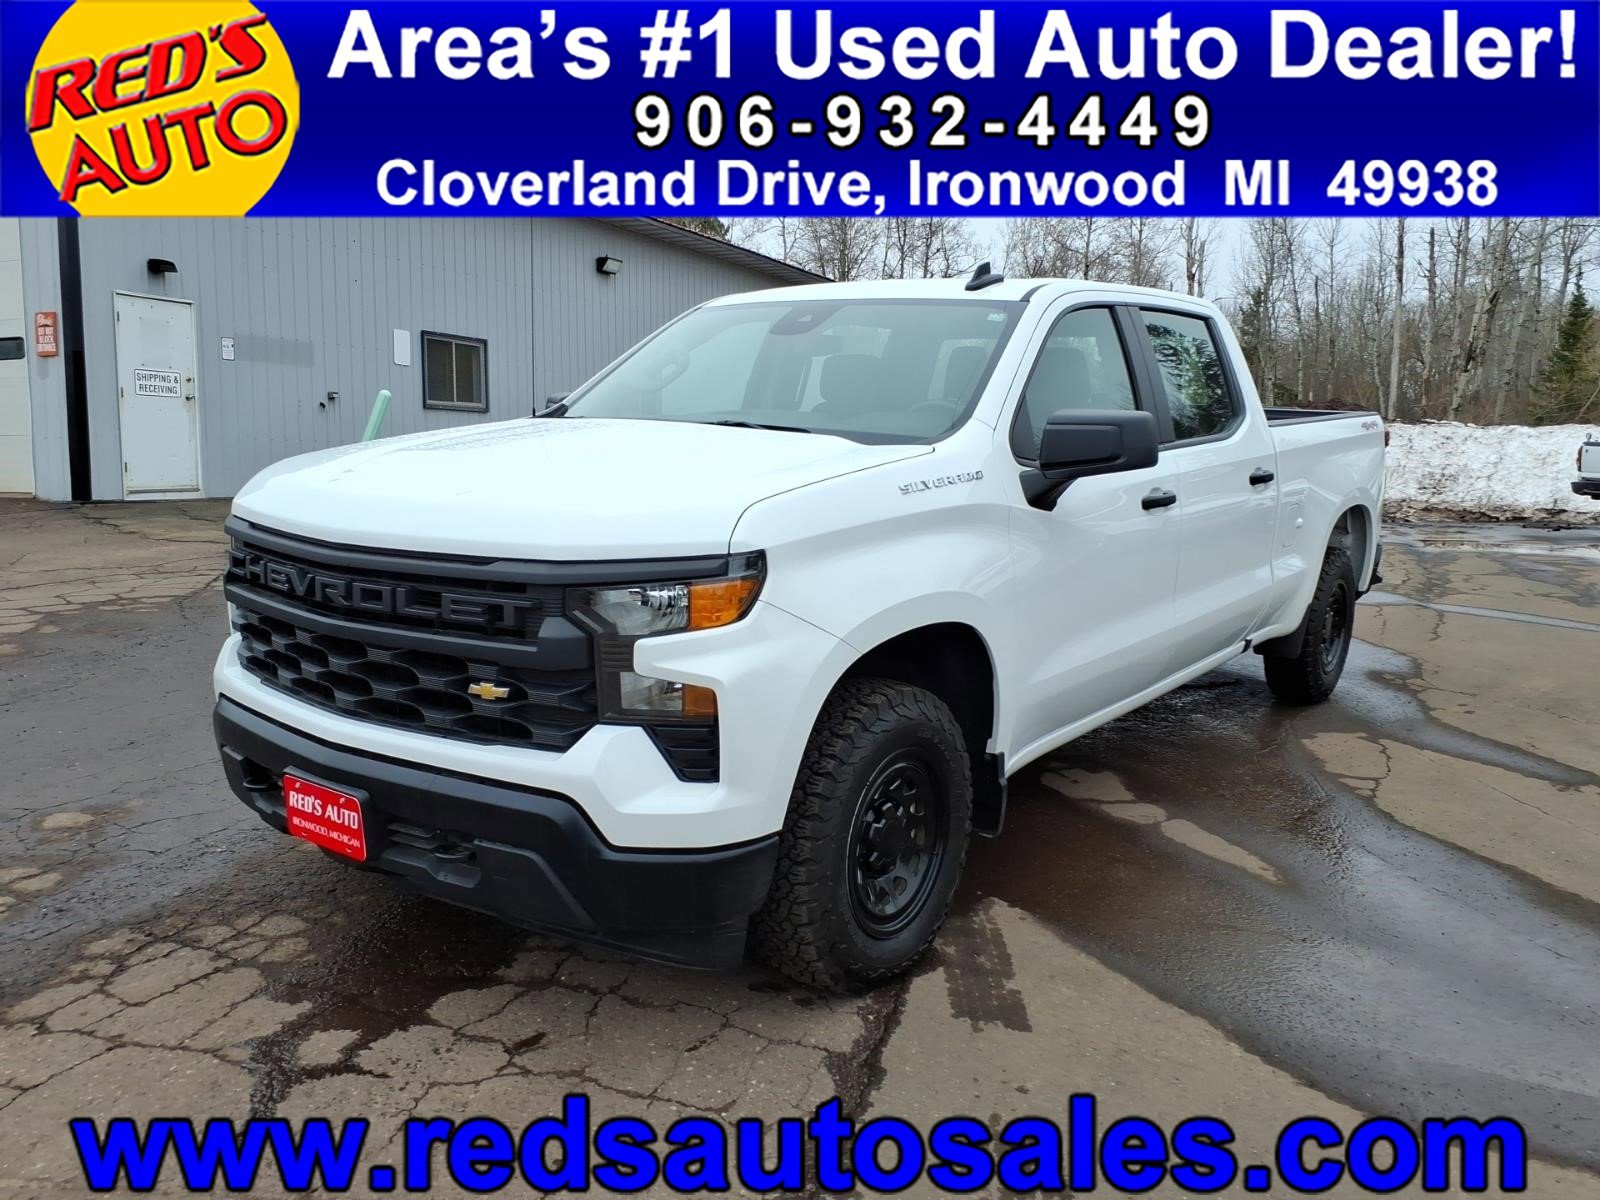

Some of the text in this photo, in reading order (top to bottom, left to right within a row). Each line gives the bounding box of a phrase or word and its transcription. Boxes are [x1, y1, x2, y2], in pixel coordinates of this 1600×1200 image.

[136, 372, 179, 384] SHIPPING &
[139, 383, 178, 395] RECEIVING
[898, 470, 984, 495] SILVERADO
[230, 550, 542, 628] CHEVROLET
[289, 790, 359, 830] RED'S AUTO
[329, 828, 361, 848] MICHIGAN
